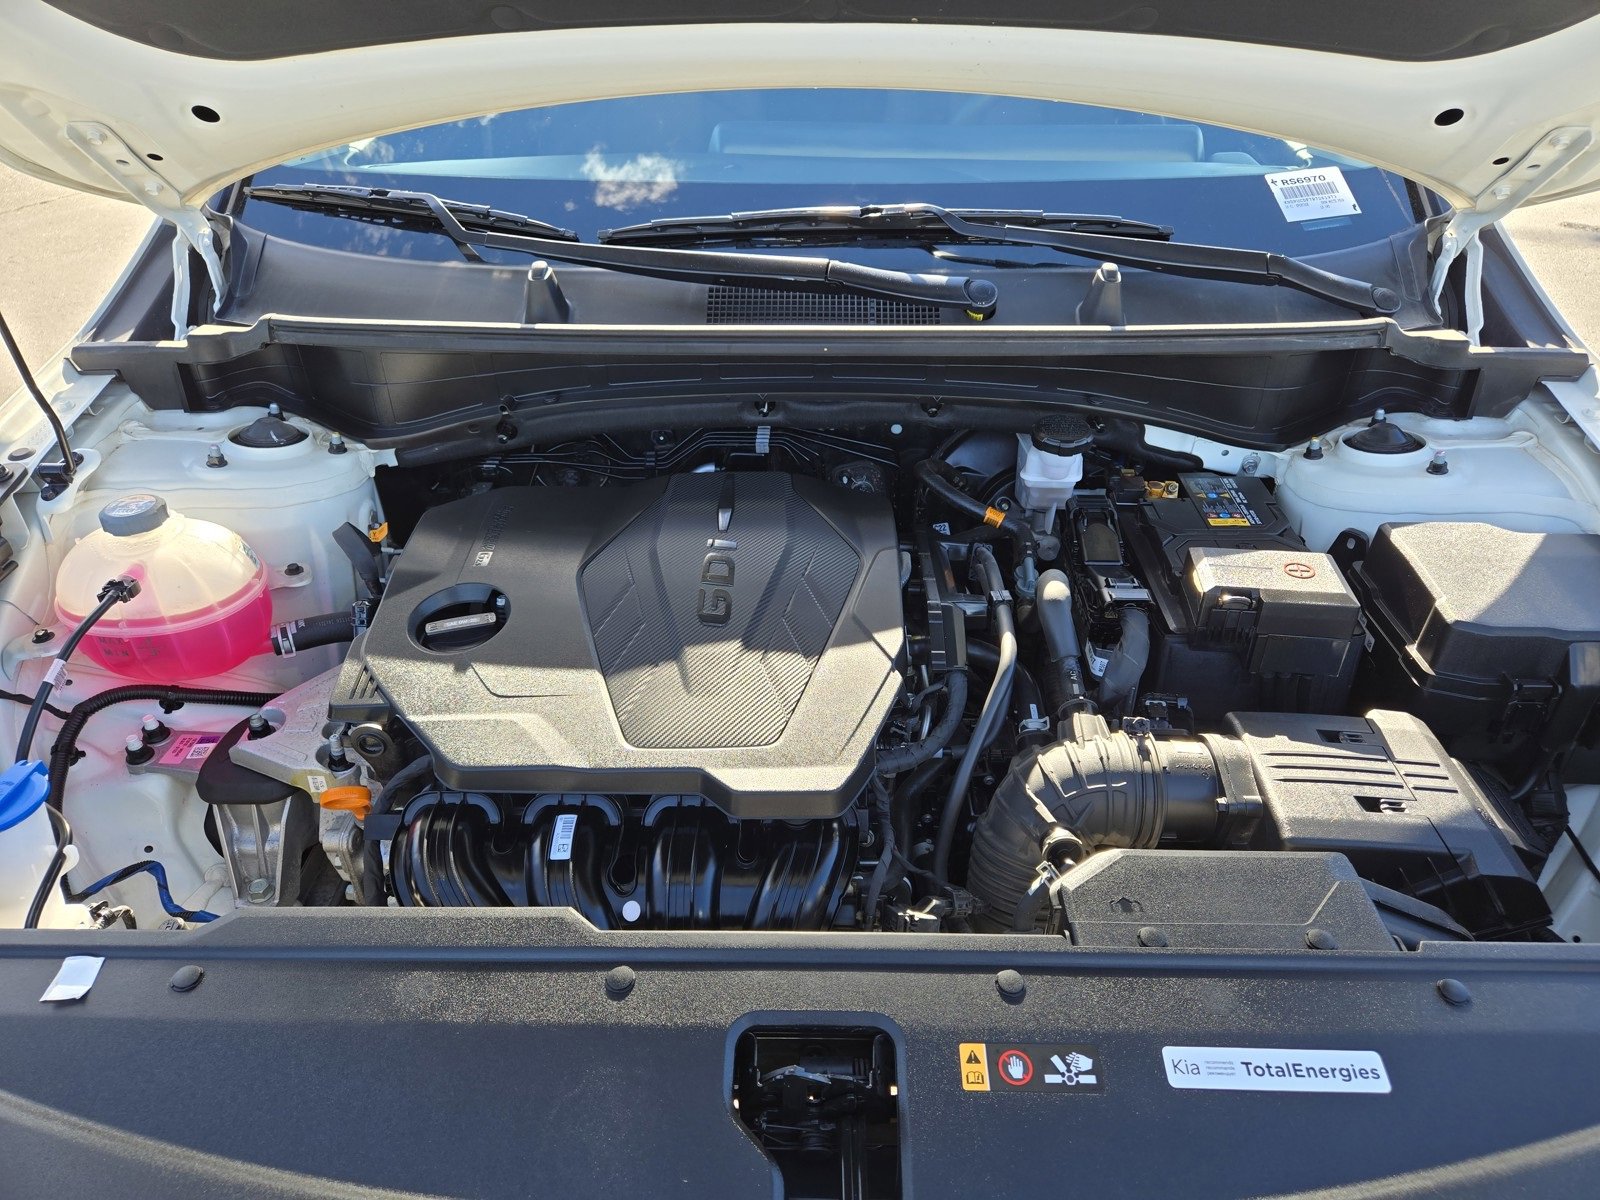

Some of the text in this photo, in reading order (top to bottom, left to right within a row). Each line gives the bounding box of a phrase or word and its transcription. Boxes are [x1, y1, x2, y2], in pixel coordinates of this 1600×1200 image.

[1280, 174, 1326, 186] RS6970
[697, 538, 737, 627] GDi
[1171, 1058, 1201, 1076] Kia
[1240, 1060, 1381, 1083] TotalEnergies
